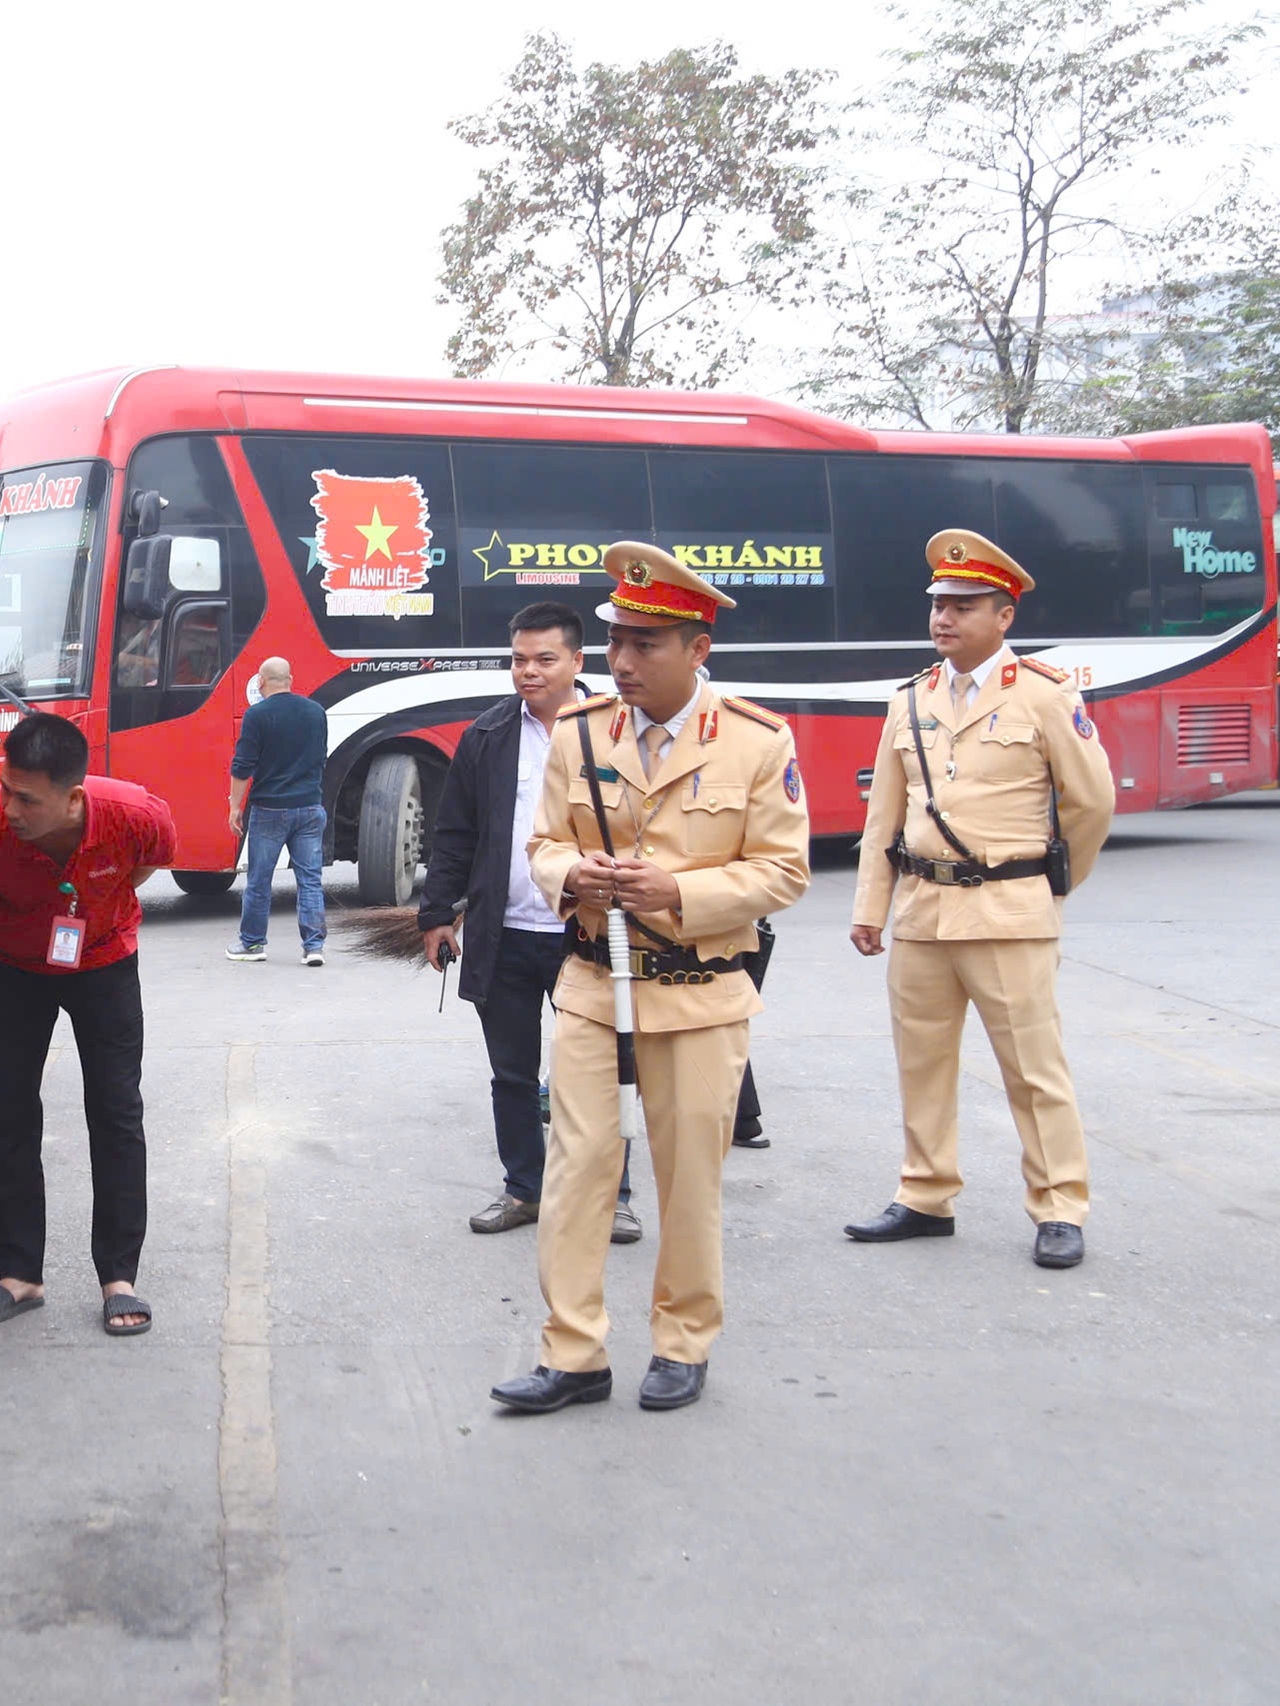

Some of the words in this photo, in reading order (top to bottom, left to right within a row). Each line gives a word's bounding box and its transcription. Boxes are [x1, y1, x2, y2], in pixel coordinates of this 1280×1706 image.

[1173, 527, 1212, 549] New
[507, 543, 611, 567] PHO
[672, 540, 823, 567] KHÁNH
[1183, 546, 1255, 577] Home
[516, 573, 580, 584] LIMOUSINE
